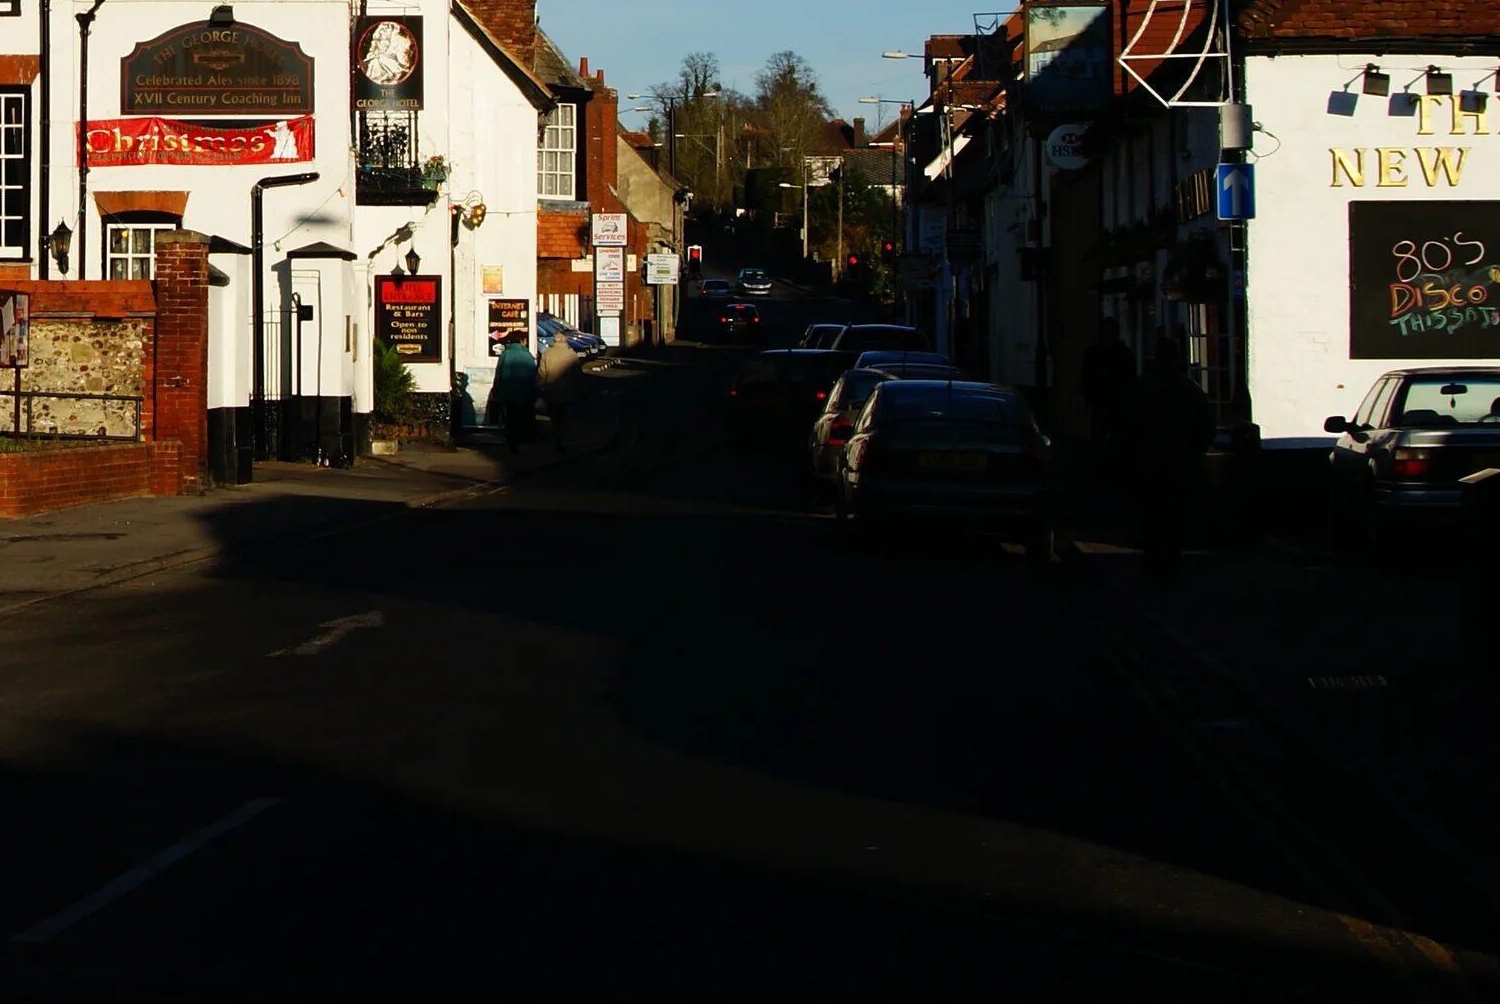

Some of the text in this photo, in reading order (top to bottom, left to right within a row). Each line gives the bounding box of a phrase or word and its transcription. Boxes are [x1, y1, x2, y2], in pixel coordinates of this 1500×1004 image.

[152, 45, 177, 66] THE
[181, 30, 239, 49] GEORGE
[135, 73, 300, 86] Celebrated Ales since 1898
[133, 92, 301, 106] XVII Century Coaching Inn
[1409, 94, 1500, 136] TH
[85, 125, 266, 154] Christmas
[1328, 147, 1473, 187] NEW
[597, 214, 621, 222] Sprint
[594, 233, 626, 241] Services
[1388, 281, 1489, 318] DISCO
[385, 303, 431, 311] Restaurant
[390, 321, 415, 329] Open
